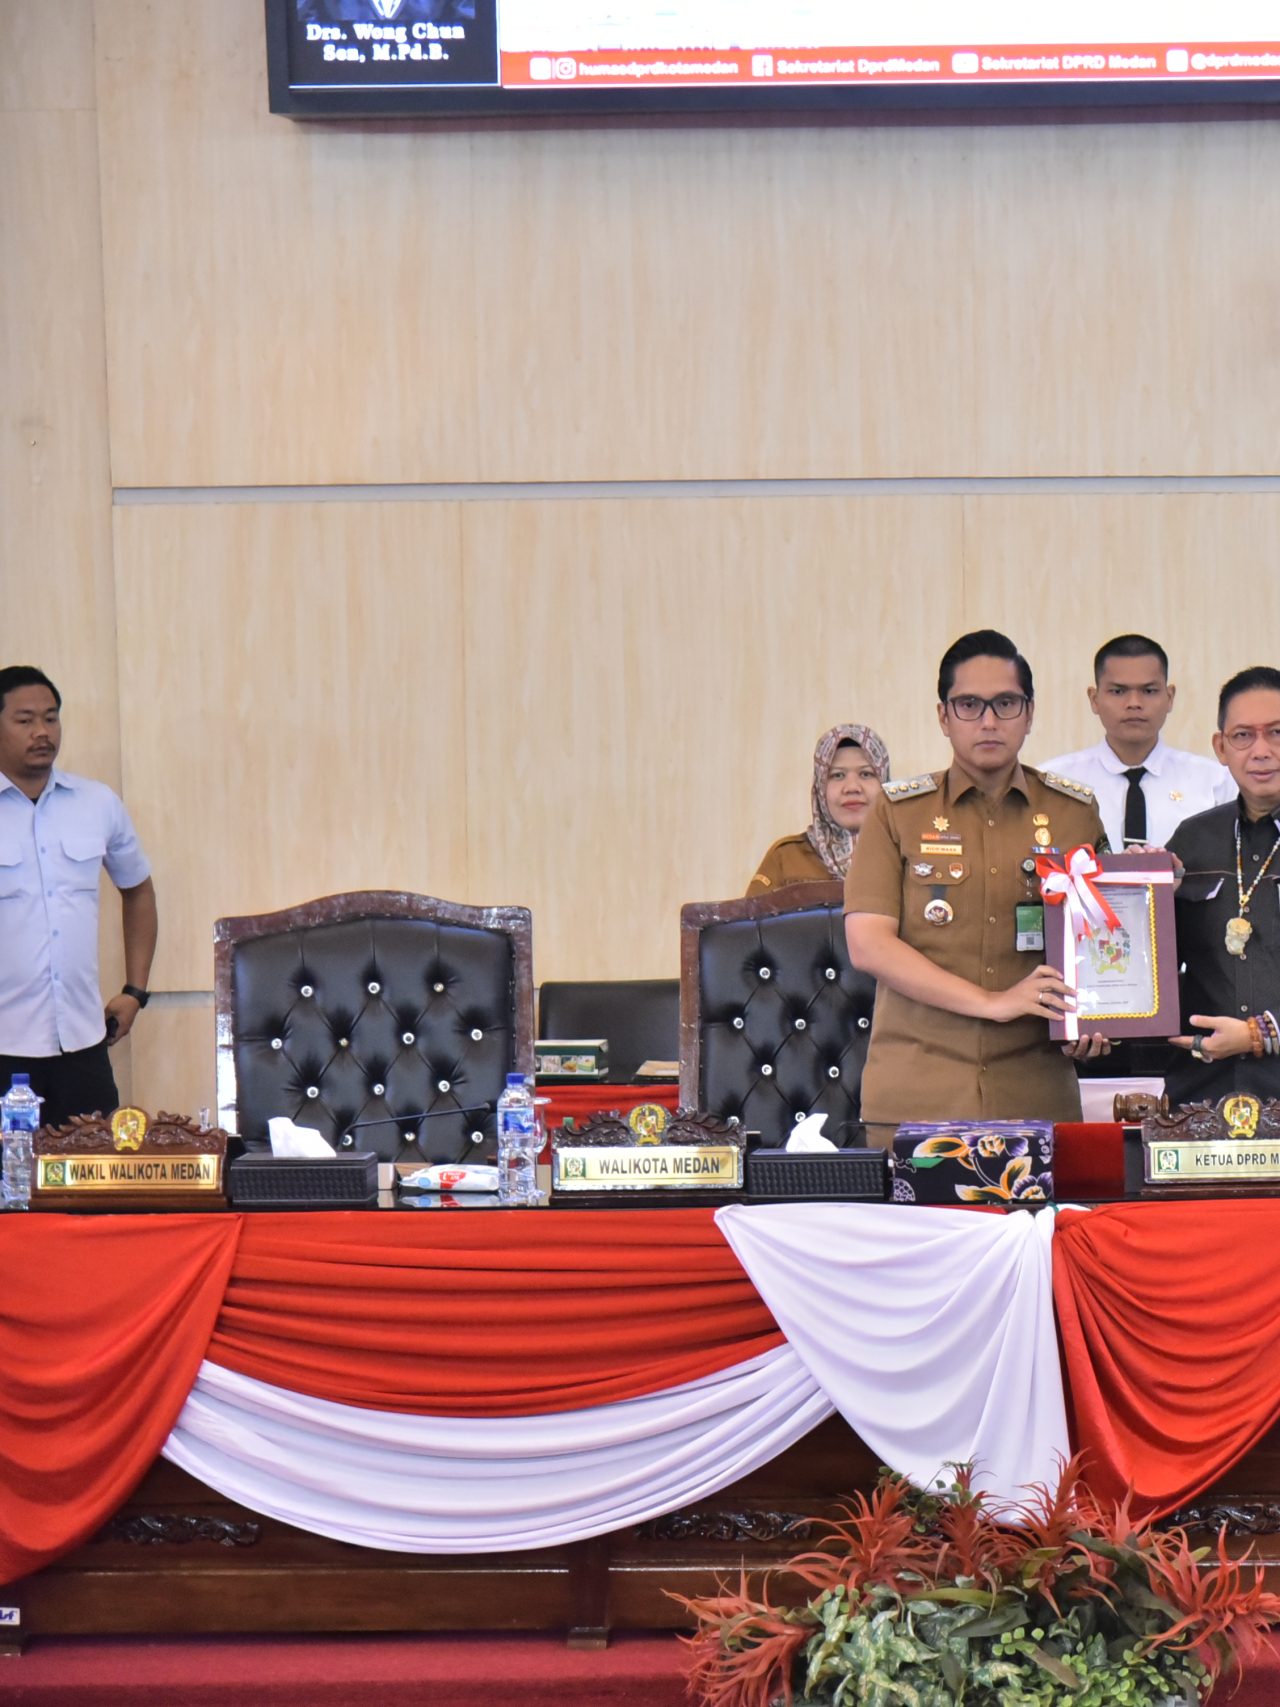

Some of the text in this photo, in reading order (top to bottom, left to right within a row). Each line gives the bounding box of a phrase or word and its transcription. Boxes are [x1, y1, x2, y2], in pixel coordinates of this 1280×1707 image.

[306, 23, 465, 44] Drs. Wong Chun
[1061, 55, 1106, 70] DPRD
[1108, 55, 1157, 69] Medan
[599, 1156, 720, 1175] WALIKOTA MEDAN
[1195, 1153, 1233, 1167] KETUA
[1236, 1153, 1267, 1166] DPRD
[69, 1162, 210, 1180] WAKIL WALIKOTA MEDAN
